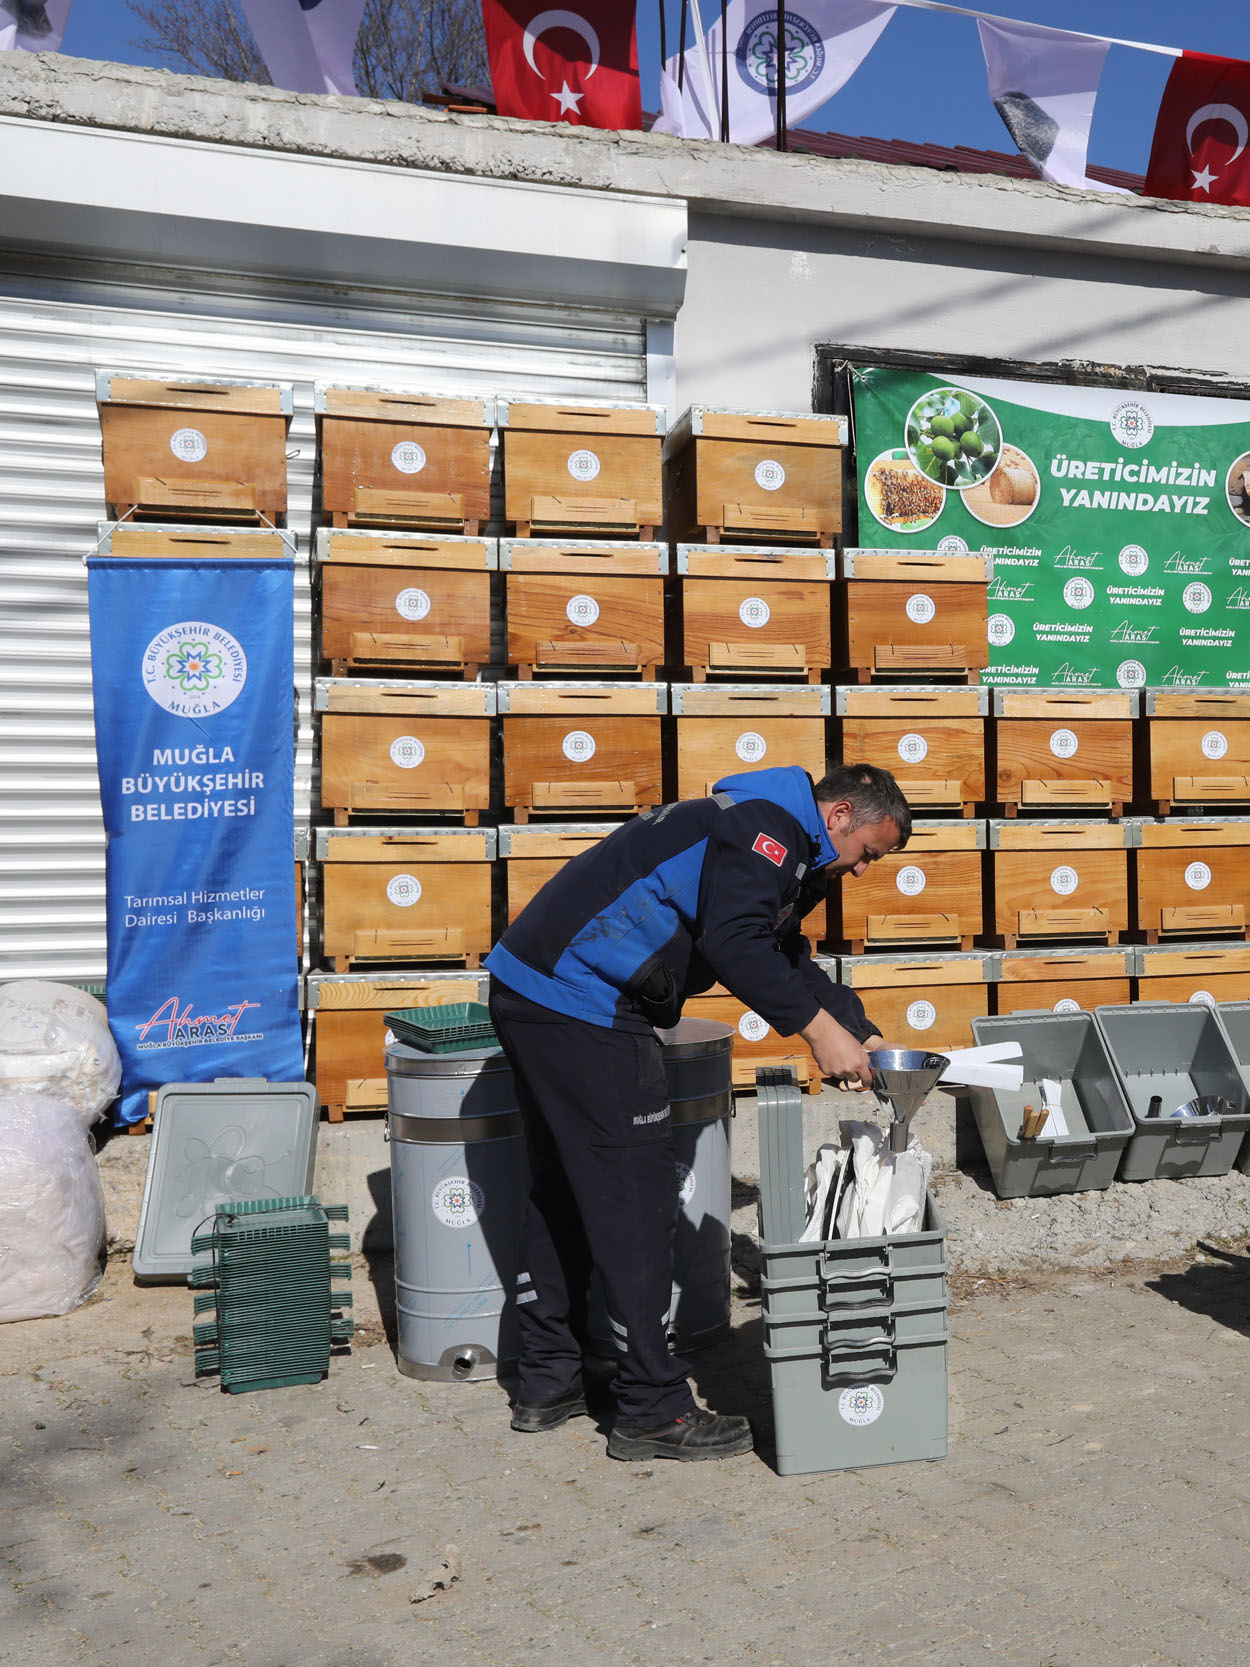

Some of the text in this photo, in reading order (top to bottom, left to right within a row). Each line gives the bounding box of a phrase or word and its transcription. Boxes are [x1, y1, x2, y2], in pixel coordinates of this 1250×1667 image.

[1121, 440, 1143, 448] MUĞLA
[1050, 454, 1217, 487] ÜRETİCİMİZİN
[1060, 488, 1210, 515] YANINDAYIZ
[994, 558, 1039, 567] NINDAYIZ
[1054, 545, 1103, 566] Ahmet
[1164, 551, 1212, 571] Ahmet
[987, 576, 1034, 598] Ahmet
[1106, 585, 1165, 596] ÜRETİCİMİZİN
[1109, 597, 1162, 606] YANINDAYIZ
[1033, 622, 1093, 633] ÜRETİCİMİZİN
[1111, 619, 1160, 640] Ahmet
[1179, 627, 1235, 638] ÜRETİCİMİZİN
[1036, 633, 1090, 643] YANINDAYIZ
[1182, 638, 1233, 647] YANINDAYIZ
[146, 626, 243, 684] T.C. BÜYÜKŞEHİR BELEDİYESİ
[982, 676, 1037, 685] YANINDAYIZ
[1052, 662, 1101, 682] Ahmet
[1162, 665, 1209, 685] Ahmet
[168, 701, 221, 714] MUĞLA
[153, 744, 235, 765] MUĞLA
[122, 769, 264, 795] BÜYÜKŞEHİR
[131, 796, 255, 821] BELEDİYESİ
[124, 888, 265, 908] Tarımsal Hizmetler
[125, 906, 265, 927] Dairesi Başkanlığı
[136, 996, 261, 1040] Ahmet
[175, 1023, 228, 1040] ARAS
